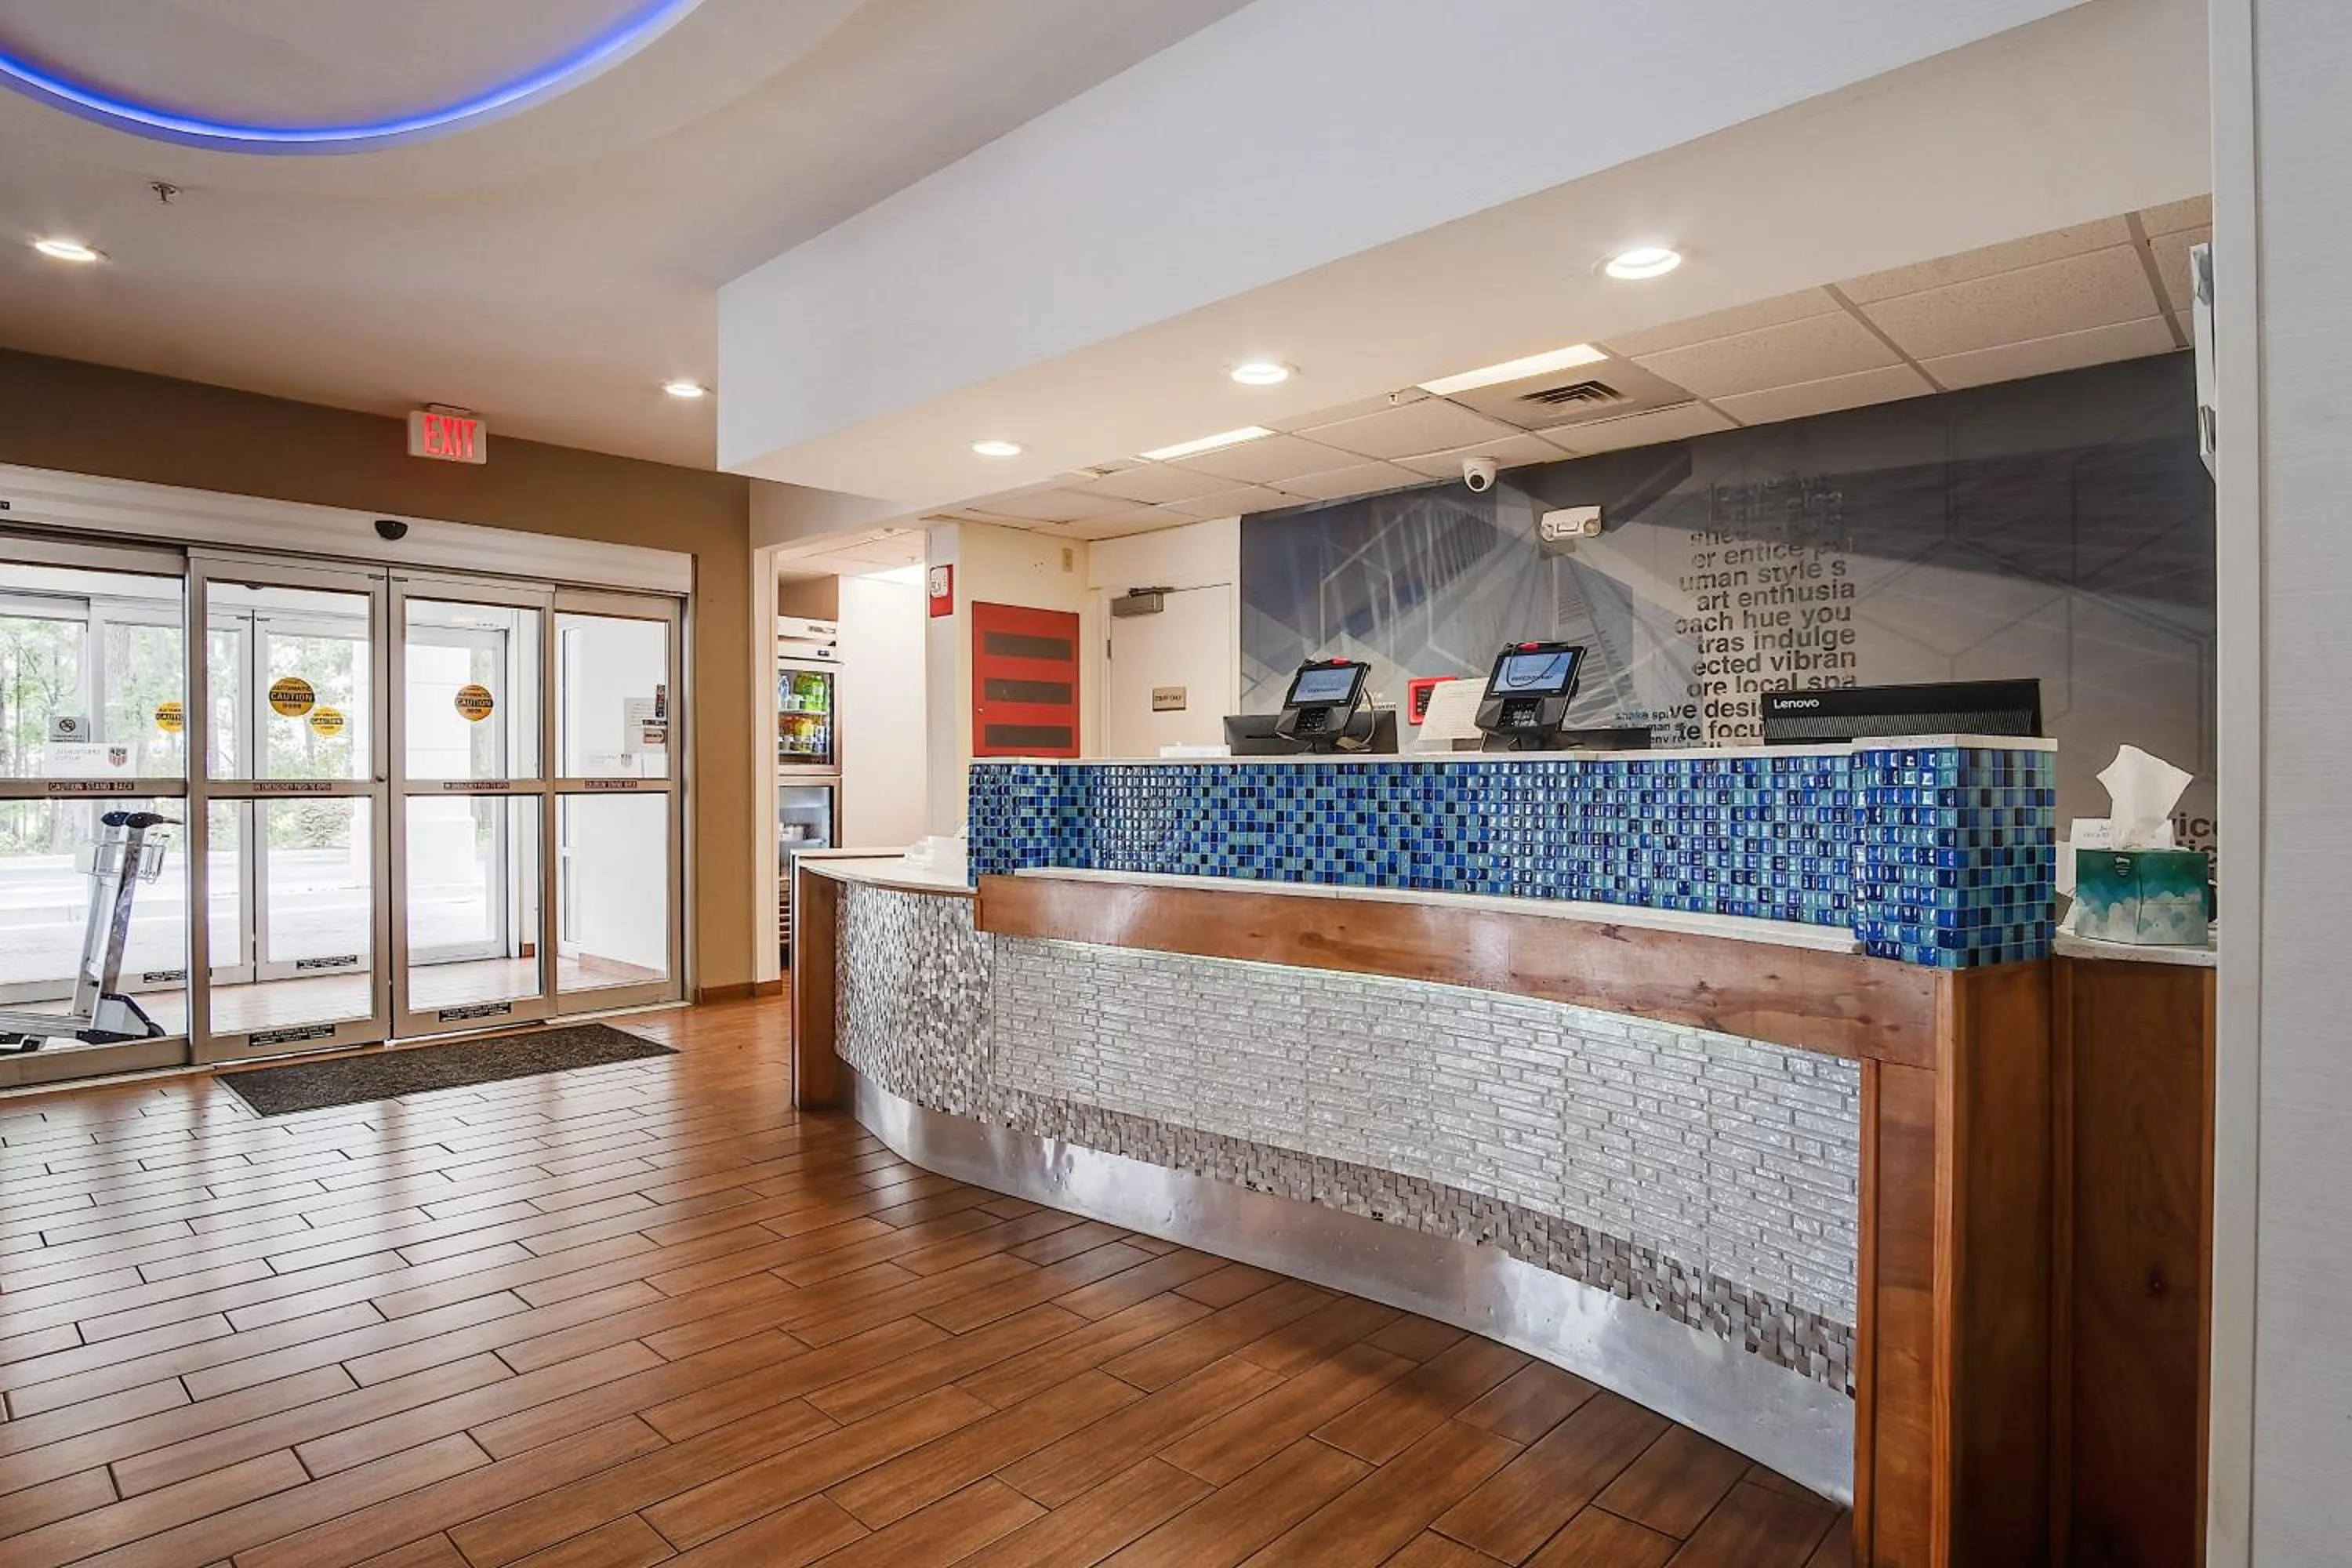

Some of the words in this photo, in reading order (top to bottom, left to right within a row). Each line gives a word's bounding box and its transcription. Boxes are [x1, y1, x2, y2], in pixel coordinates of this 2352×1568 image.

[424, 413, 477, 459] EXIT
[1679, 569, 1748, 592] uman
[1758, 559, 1824, 586] style
[1831, 559, 1846, 577] s
[1697, 590, 1730, 612] art
[1737, 579, 1856, 608] enthusia
[1743, 609, 1791, 630] hue
[1801, 604, 1852, 630] you
[1753, 626, 1856, 652] indulge
[1693, 652, 1762, 676] ected
[1769, 649, 1857, 672] vibran
[270, 691, 313, 702] CAUTION
[1686, 679, 1728, 698] ore
[1735, 673, 1798, 693] local
[1704, 699, 1765, 722] desi
[1773, 698, 1820, 710] Lenovo
